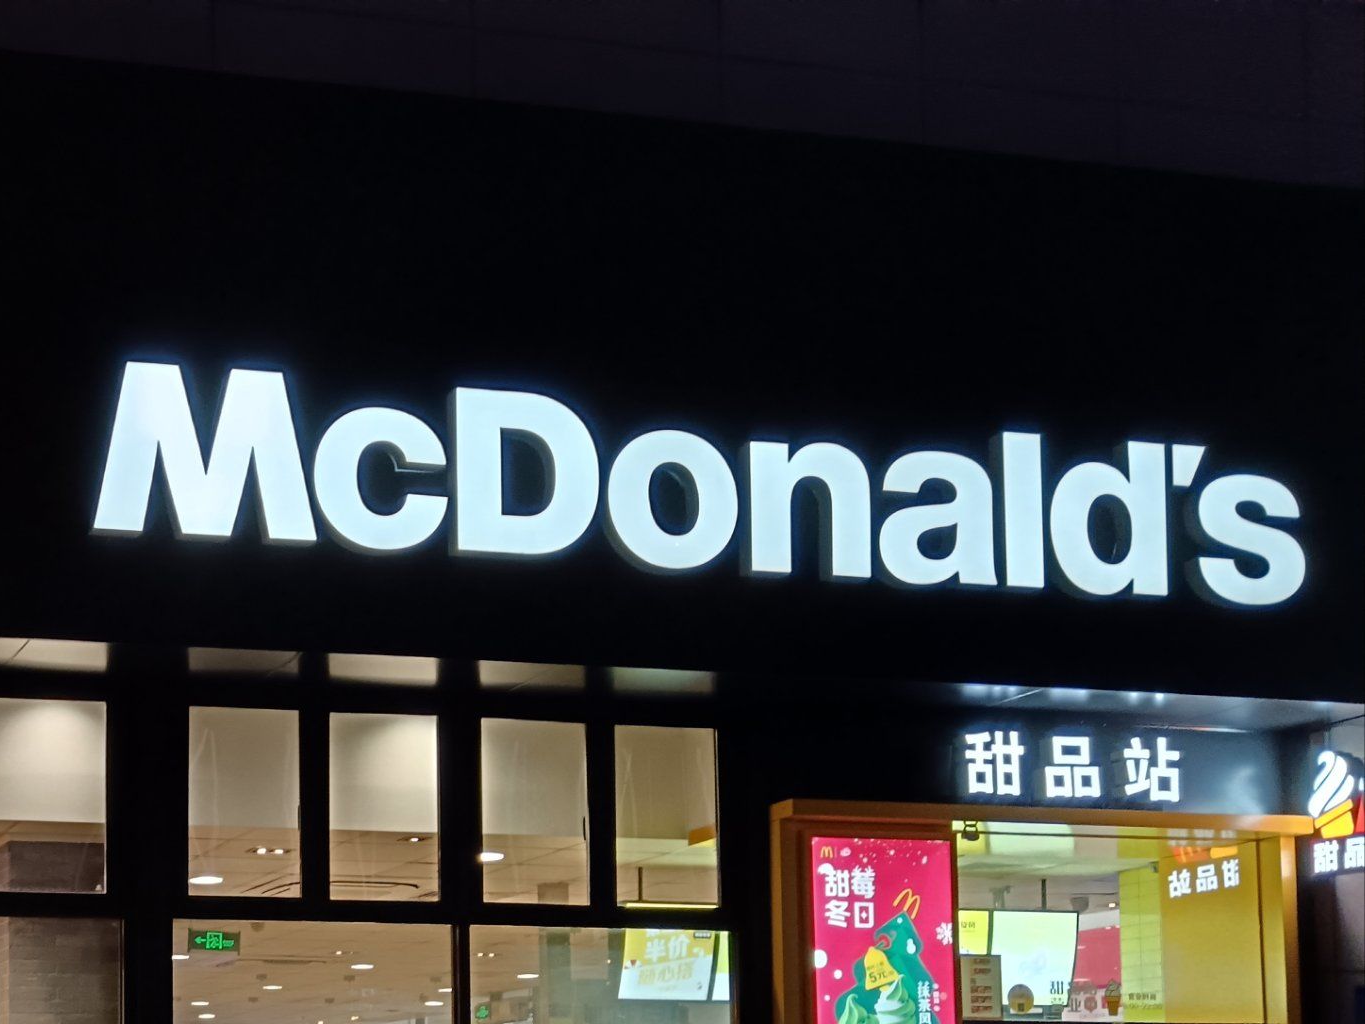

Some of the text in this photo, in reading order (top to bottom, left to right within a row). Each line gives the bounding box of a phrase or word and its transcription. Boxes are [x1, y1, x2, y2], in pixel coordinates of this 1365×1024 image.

[92, 360, 1307, 607] McDonald's
[965, 731, 1180, 802] 甜品站
[825, 900, 875, 929] 冬日
